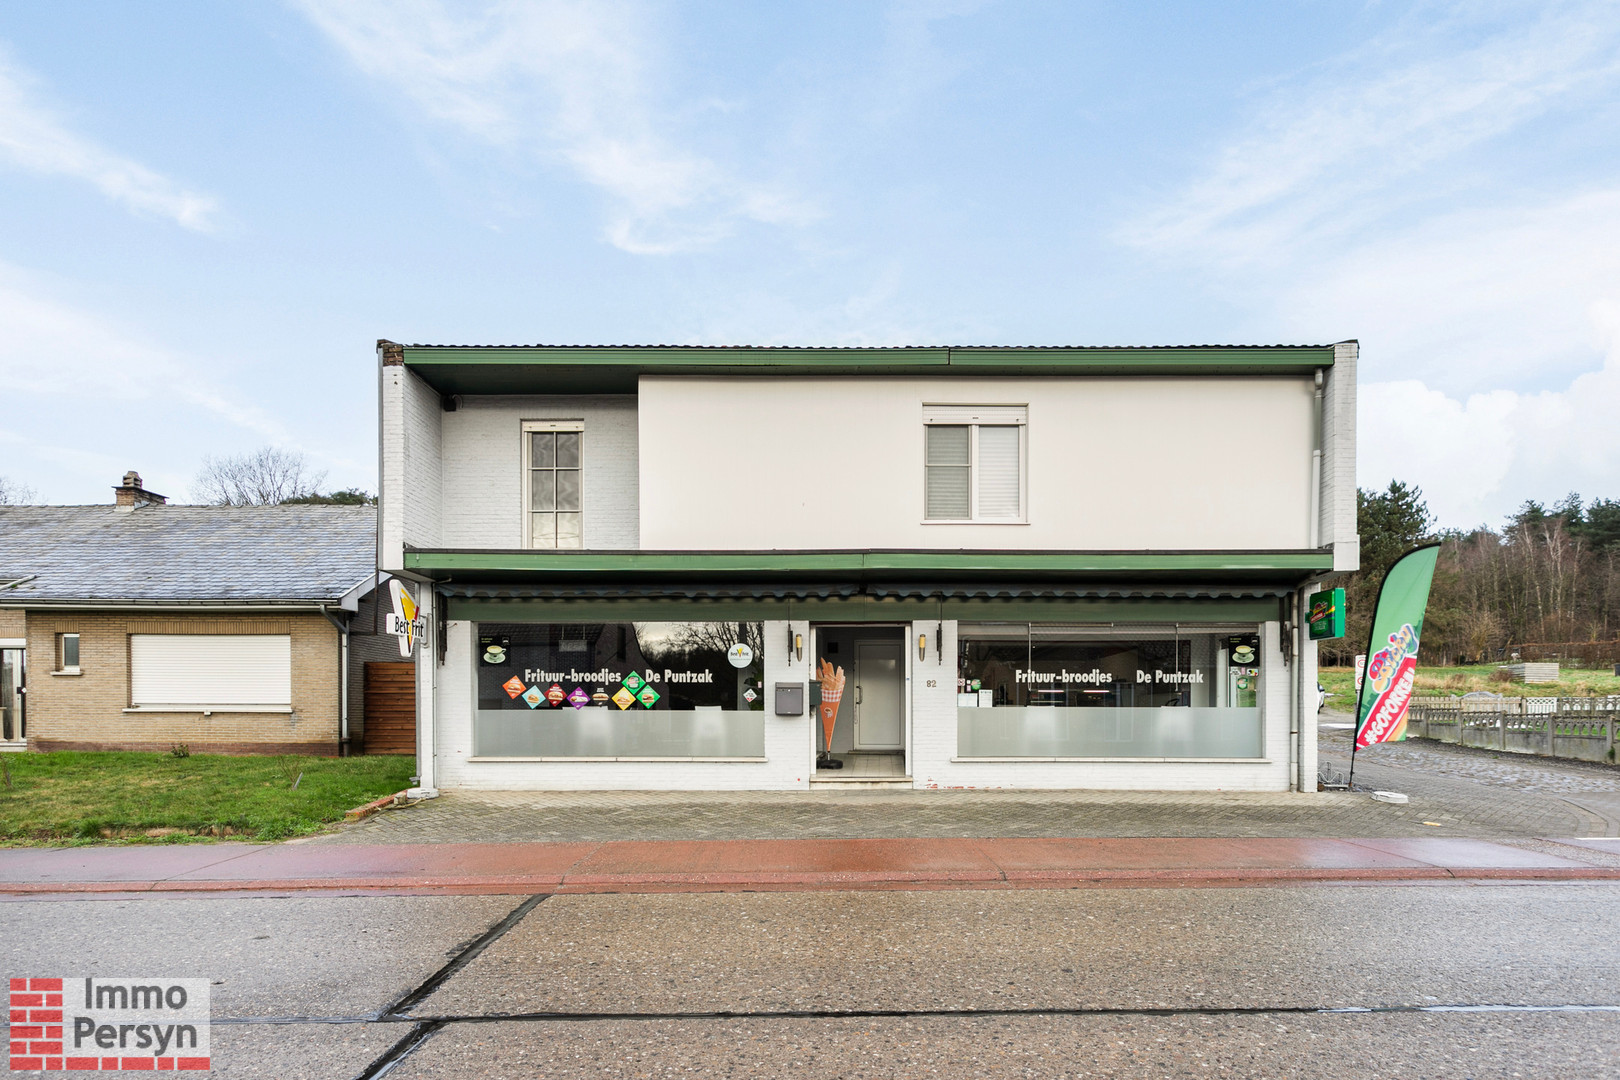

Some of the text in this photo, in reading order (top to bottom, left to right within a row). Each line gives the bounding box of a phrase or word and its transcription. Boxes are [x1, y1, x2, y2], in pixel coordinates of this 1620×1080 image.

[394, 615, 424, 638] Best Frit
[524, 668, 622, 686] Frituur-broodjes
[645, 668, 661, 683] De
[664, 668, 713, 683] Puntzak
[926, 679, 937, 688] 82
[1015, 668, 1204, 686] Frituur-broodjes De Puntzak
